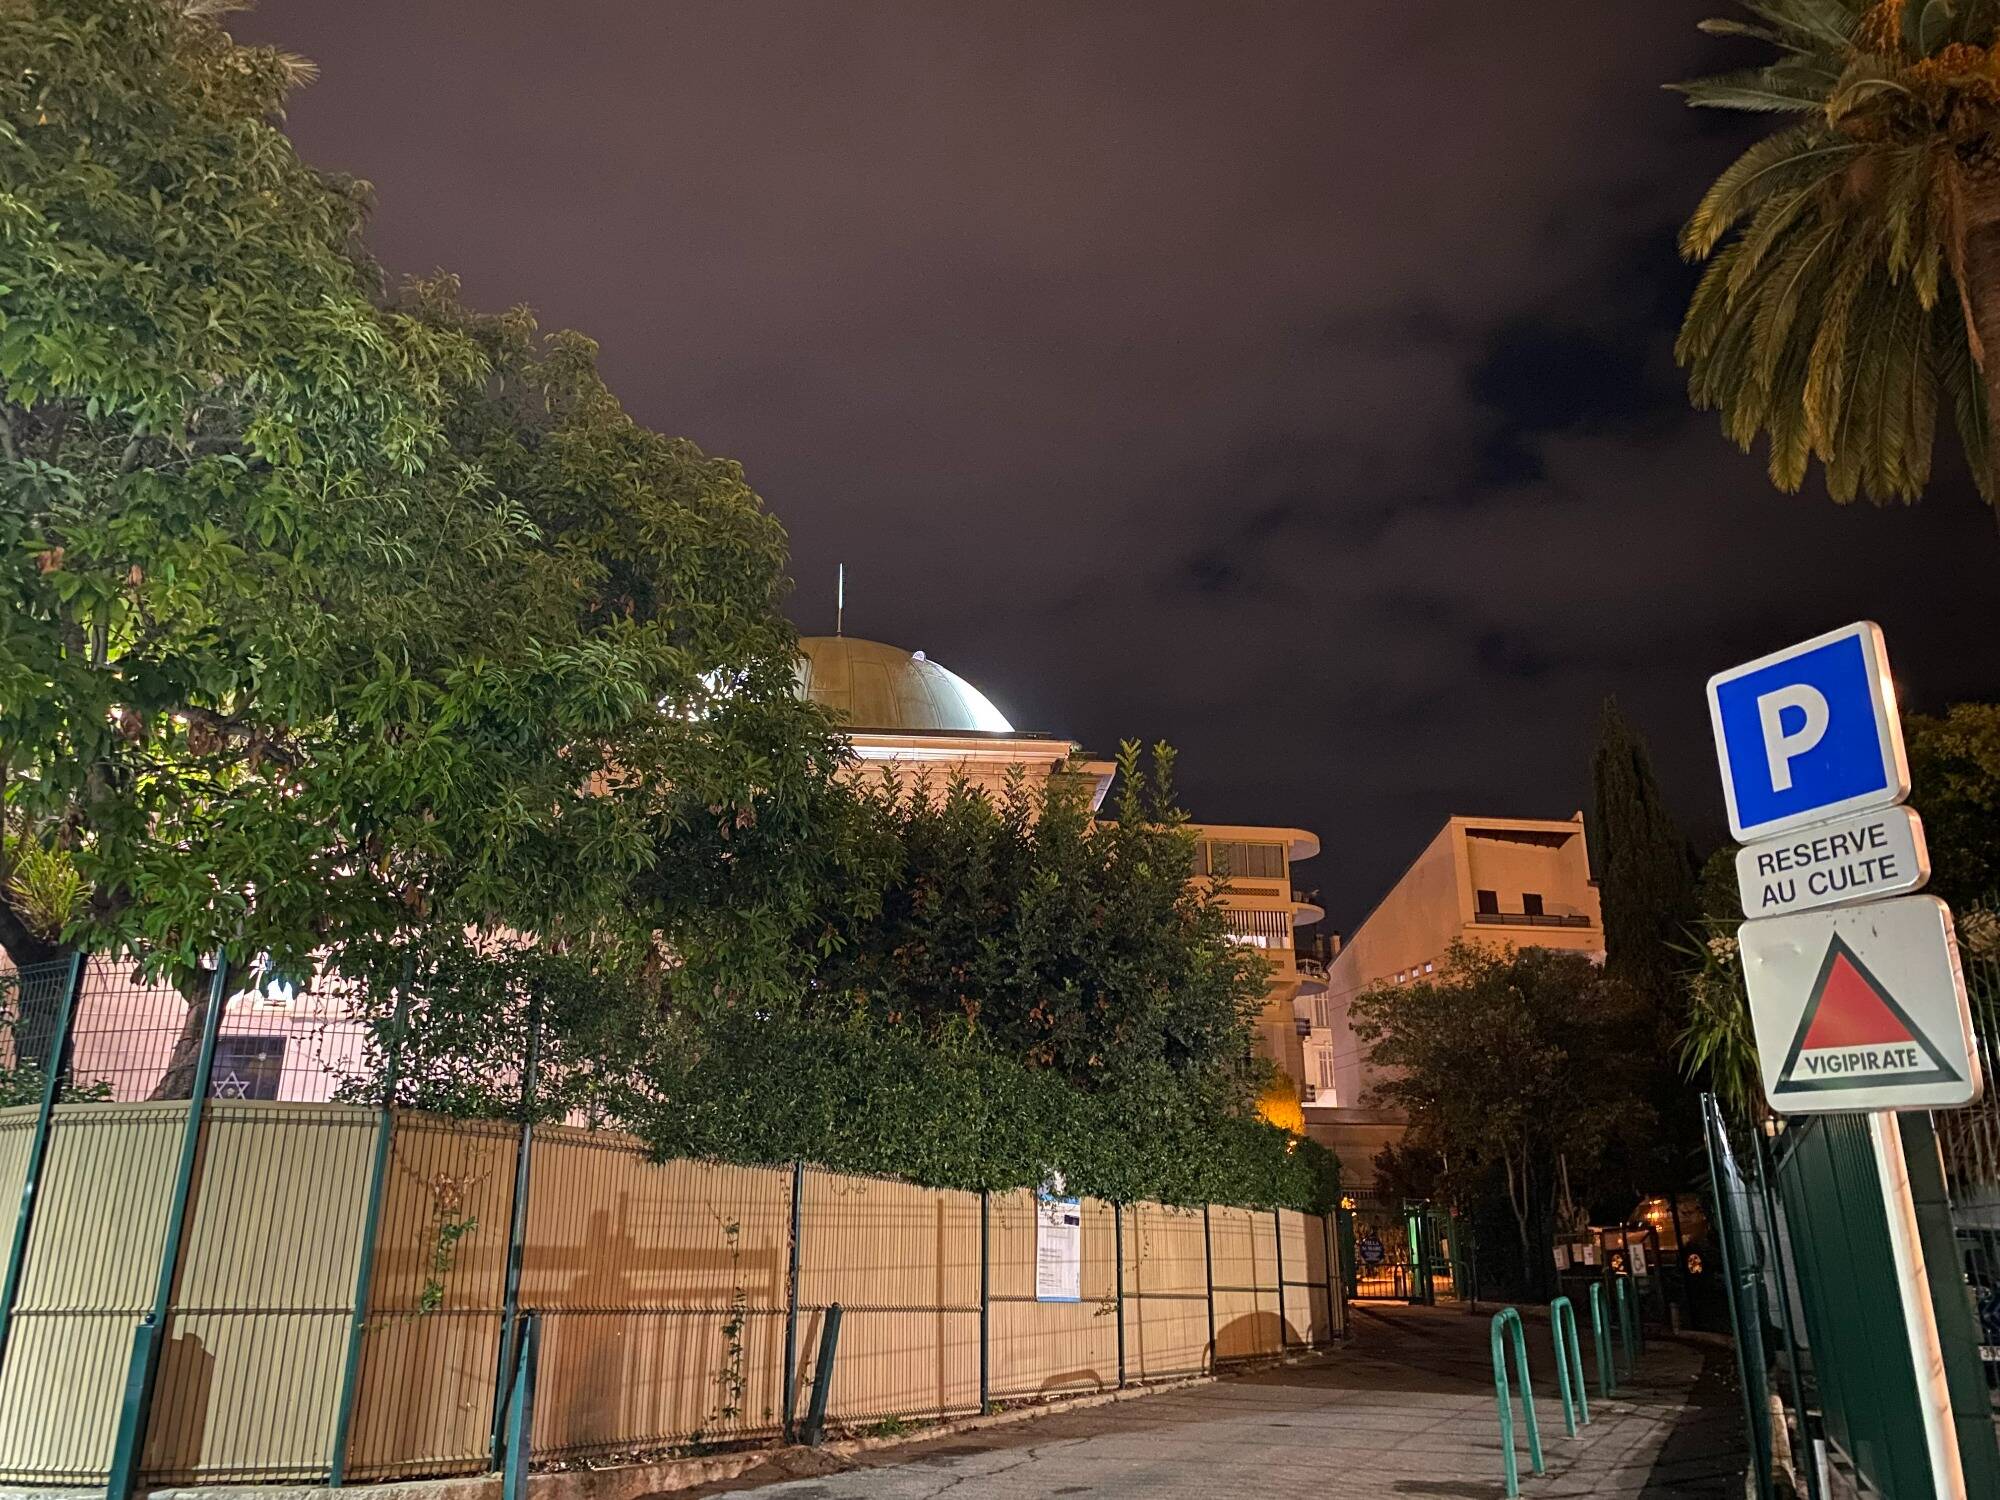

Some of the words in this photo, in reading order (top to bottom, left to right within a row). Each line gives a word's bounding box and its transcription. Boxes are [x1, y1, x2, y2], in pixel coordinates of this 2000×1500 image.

[1757, 684, 1829, 792] P
[1757, 823, 1888, 876] RESERVE
[1762, 879, 1796, 907] AU
[1808, 854, 1898, 895] CULTE
[1805, 1048, 1918, 1074] VIGIPIRATE
